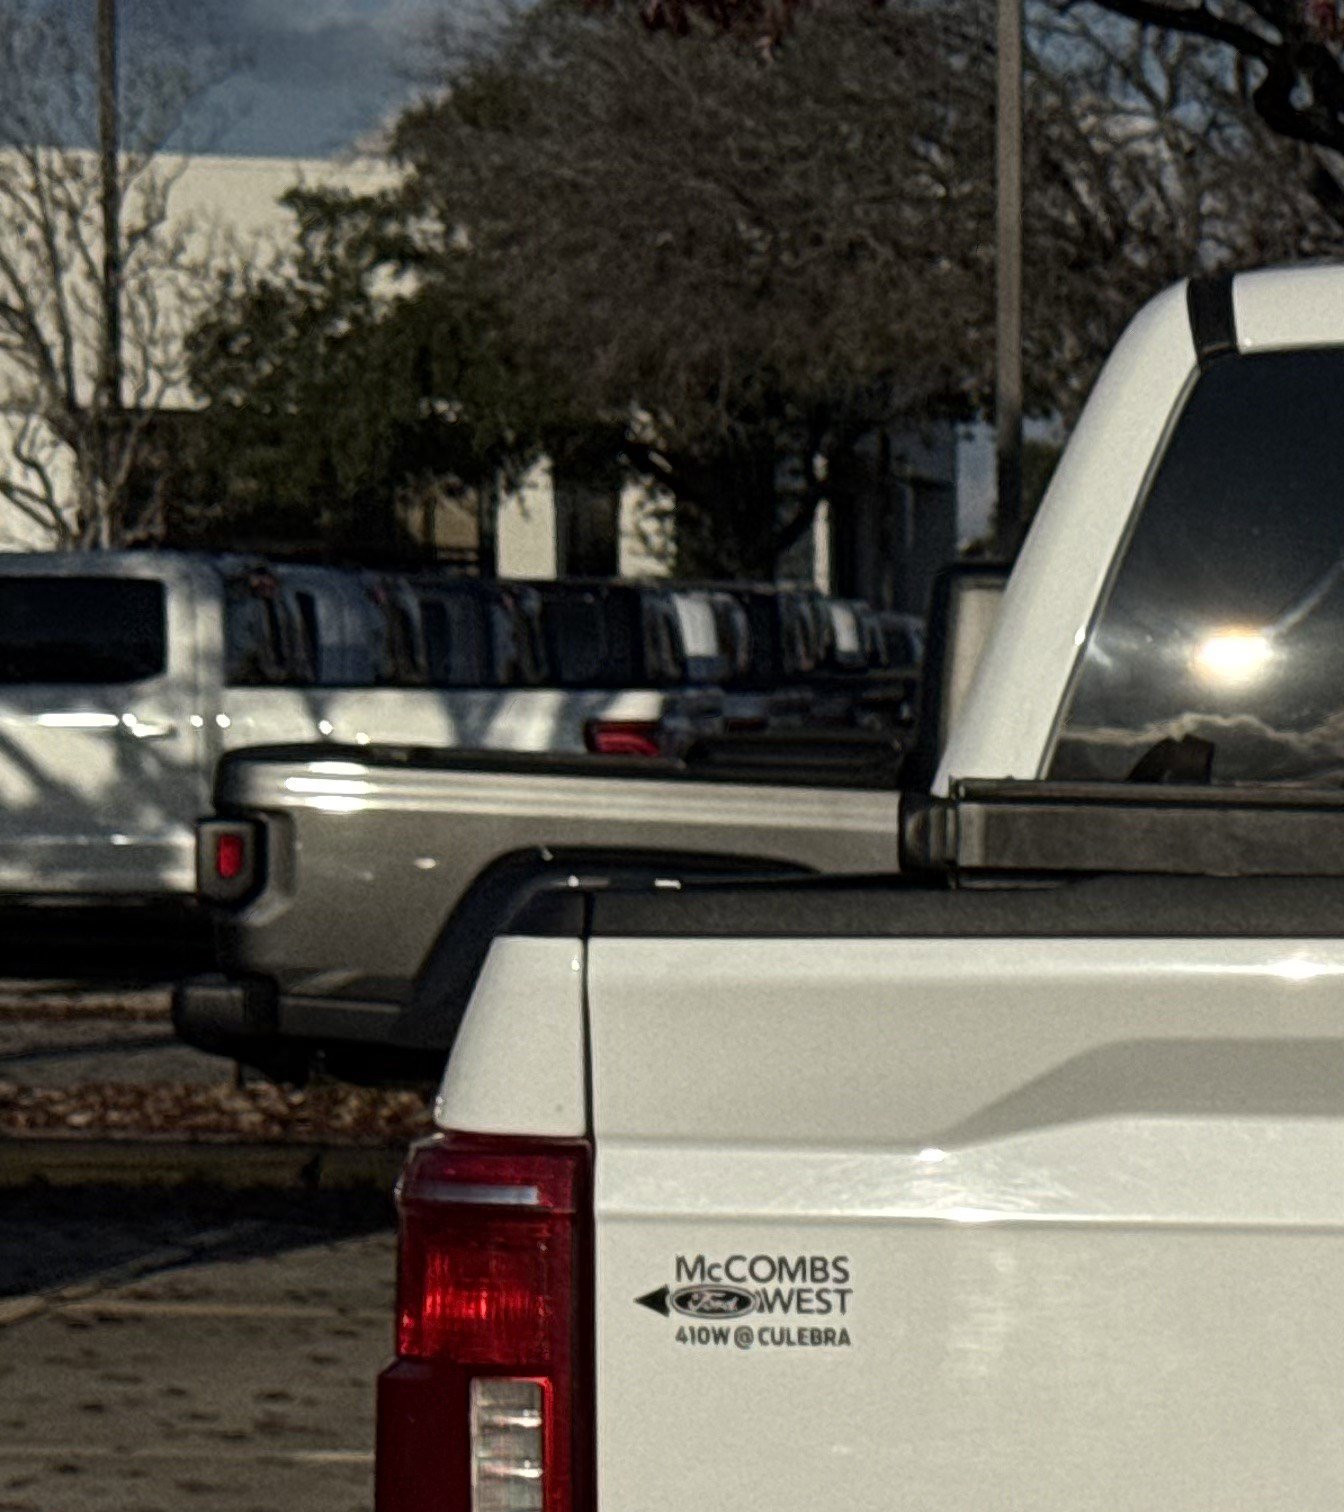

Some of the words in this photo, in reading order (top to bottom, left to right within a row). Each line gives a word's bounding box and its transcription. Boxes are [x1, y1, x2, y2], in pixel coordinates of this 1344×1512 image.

[675, 1254, 850, 1284] McCOMBS
[761, 1287, 853, 1315] WEST
[758, 1327, 852, 1347] CULEBRA
